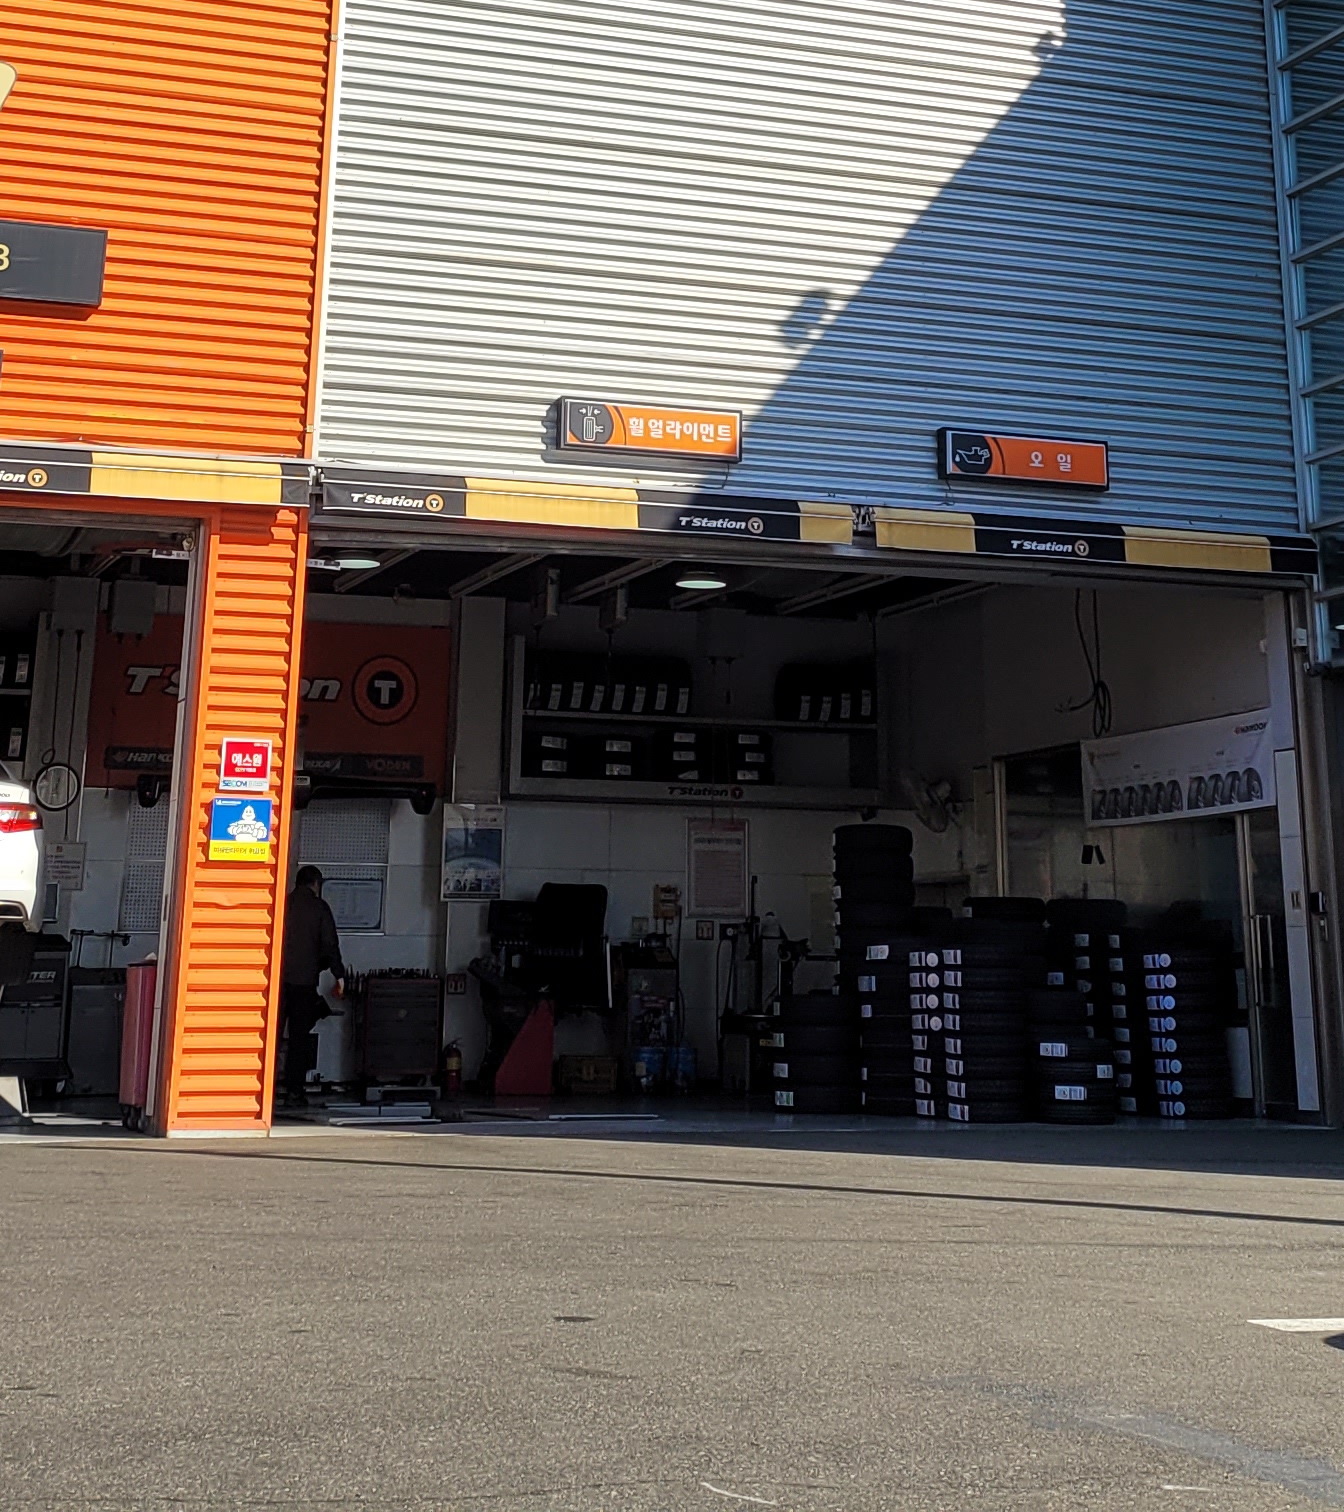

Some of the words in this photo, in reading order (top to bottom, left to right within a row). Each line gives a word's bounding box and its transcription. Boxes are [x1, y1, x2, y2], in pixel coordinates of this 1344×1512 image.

[350, 493, 424, 508] T'Station
[679, 516, 746, 529] T'Station
[1011, 540, 1073, 553] T'Station
